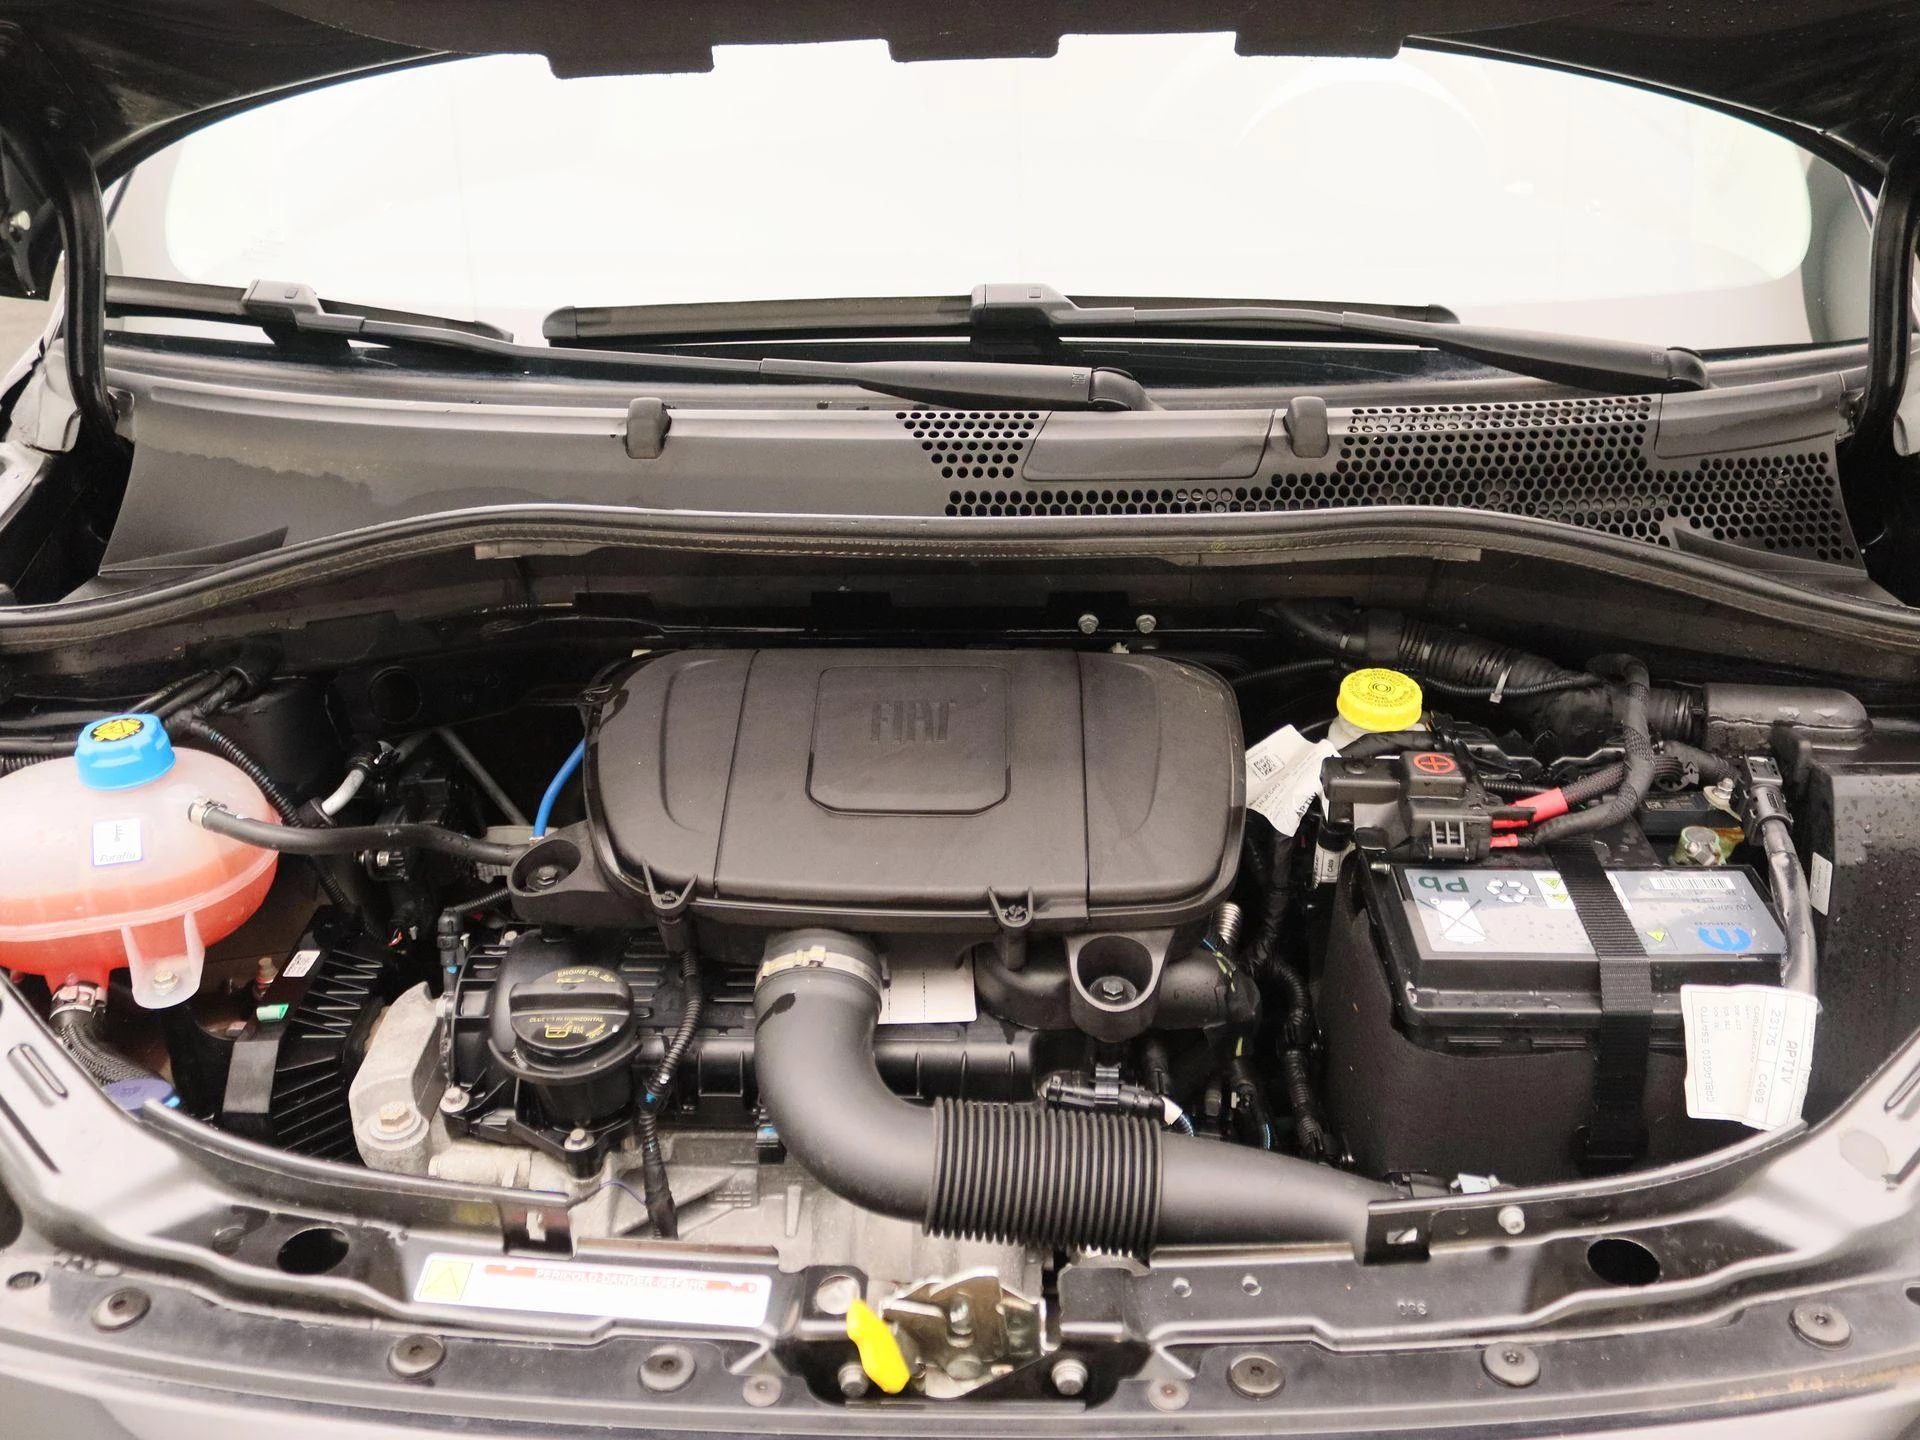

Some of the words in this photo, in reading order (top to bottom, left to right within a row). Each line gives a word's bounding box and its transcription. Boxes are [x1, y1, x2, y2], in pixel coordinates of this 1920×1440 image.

[870, 699, 957, 744] FIAT
[1418, 876, 1470, 893] Pb
[1766, 1008, 1782, 1048] 23175
[1780, 1039, 1799, 1086] APTIV
